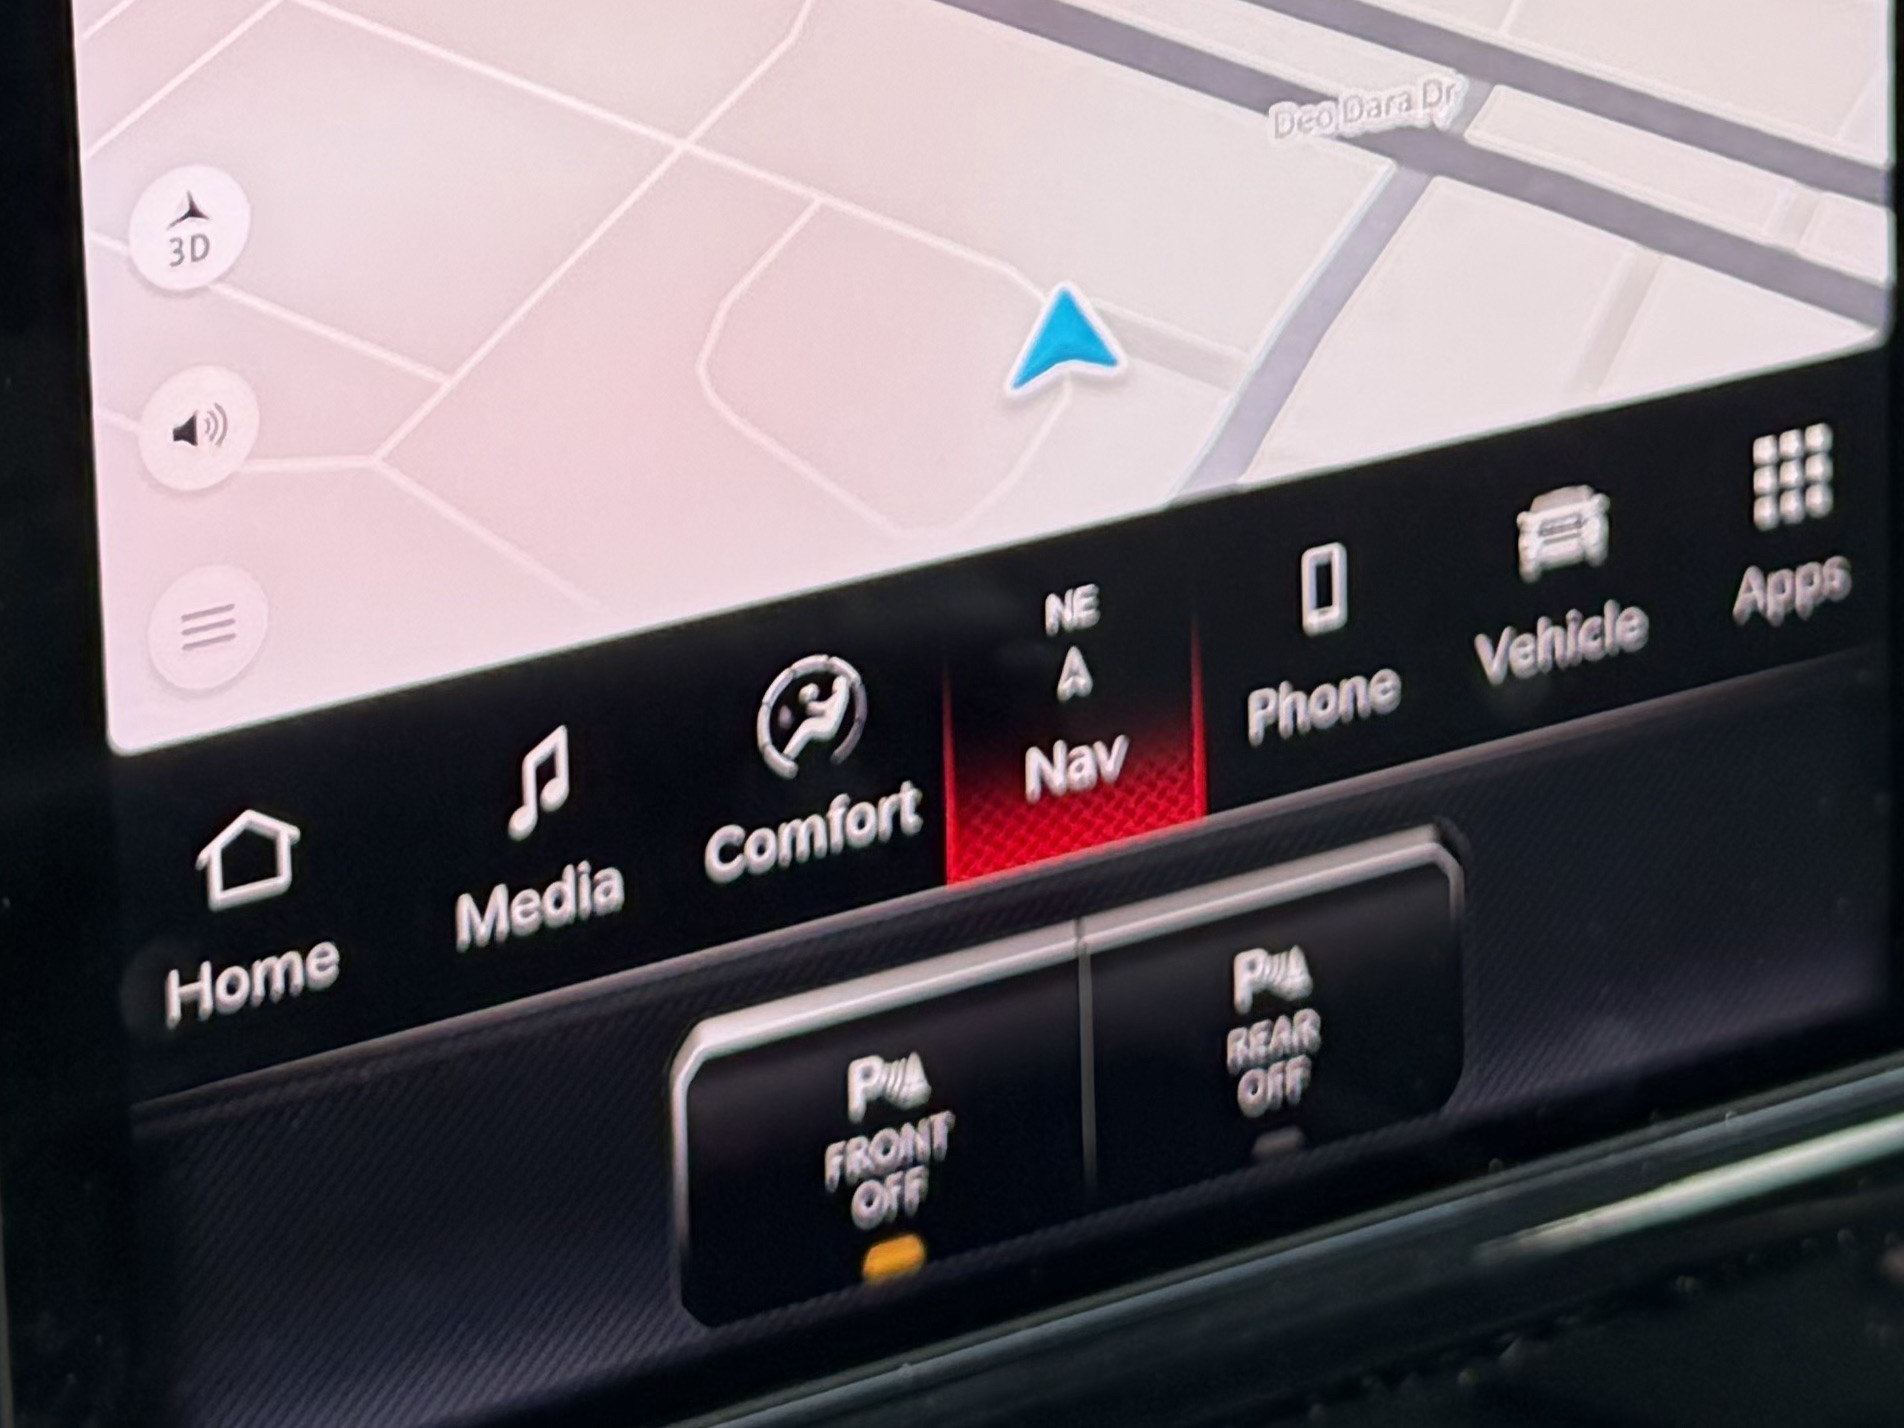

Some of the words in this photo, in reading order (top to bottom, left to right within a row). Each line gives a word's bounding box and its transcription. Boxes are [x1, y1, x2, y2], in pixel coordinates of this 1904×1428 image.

[169, 233, 211, 268] 3D
[1044, 582, 1100, 636] NE
[1732, 555, 1852, 625] Apps
[1474, 599, 1650, 685] Vehicle
[1246, 668, 1403, 746] Phone
[1024, 734, 1130, 805] Nav
[704, 779, 924, 885] Comfort
[456, 860, 626, 953] Media
[164, 940, 341, 1029] Home
[1226, 1008, 1322, 1075] REAR
[1236, 1054, 1314, 1119] OFF
[823, 1110, 956, 1193] FRONT
[849, 1164, 928, 1231] OFF
